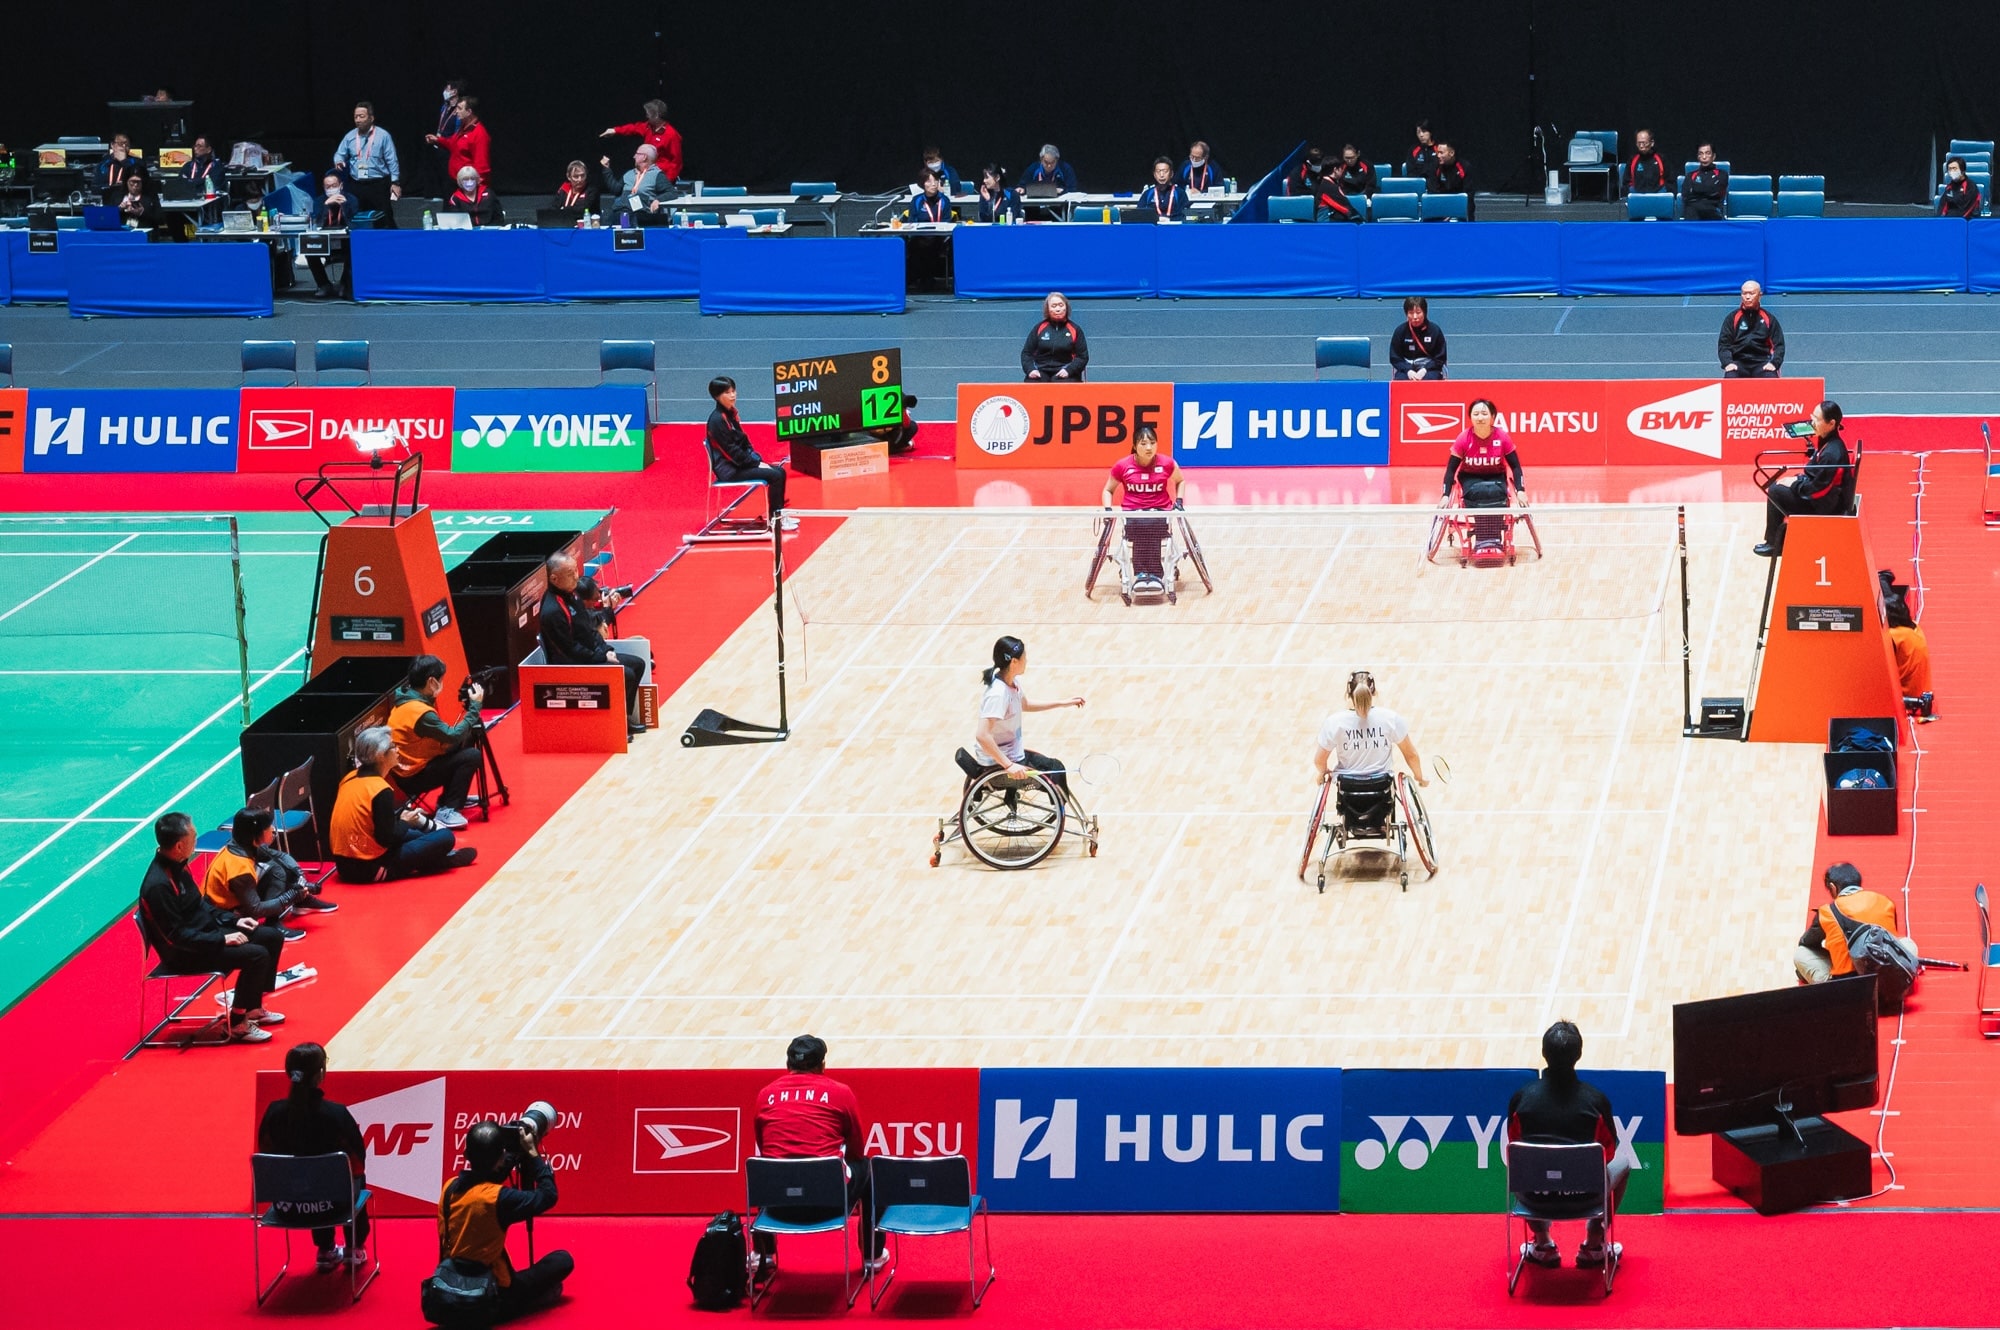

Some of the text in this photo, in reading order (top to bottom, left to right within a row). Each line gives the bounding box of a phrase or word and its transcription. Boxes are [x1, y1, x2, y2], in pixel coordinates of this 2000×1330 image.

[776, 355, 890, 384] SAT/YA 8
[791, 379, 818, 393] JPN
[792, 402, 821, 416] CHN
[864, 391, 900, 421] 12
[1726, 403, 1804, 415] BADMINTON
[528, 413, 633, 447] YONEX
[778, 414, 840, 436] LIU/YIN
[1033, 404, 1160, 445] JPBF
[1248, 408, 1381, 439] HULIC
[1493, 411, 1598, 433] AIHATSU
[1640, 411, 1714, 430] BWF
[1727, 415, 1773, 427] WORLD
[99, 415, 230, 446] HULIC
[1726, 428, 1792, 439] FEDERATI
[986, 441, 1014, 451] JPBF
[1465, 456, 1501, 466] HULIC
[1127, 483, 1163, 493] HULIC
[433, 515, 534, 525] TOKY
[354, 565, 375, 596] 6
[1815, 556, 1832, 586] 1
[643, 688, 654, 726] Interval
[1345, 729, 1363, 740] YIN
[1343, 739, 1388, 751] CHINA
[767, 1089, 829, 1105] CHINA
[357, 1123, 434, 1156] WF
[1105, 1114, 1324, 1163] HULIC
[295, 1200, 334, 1214] YONEX
